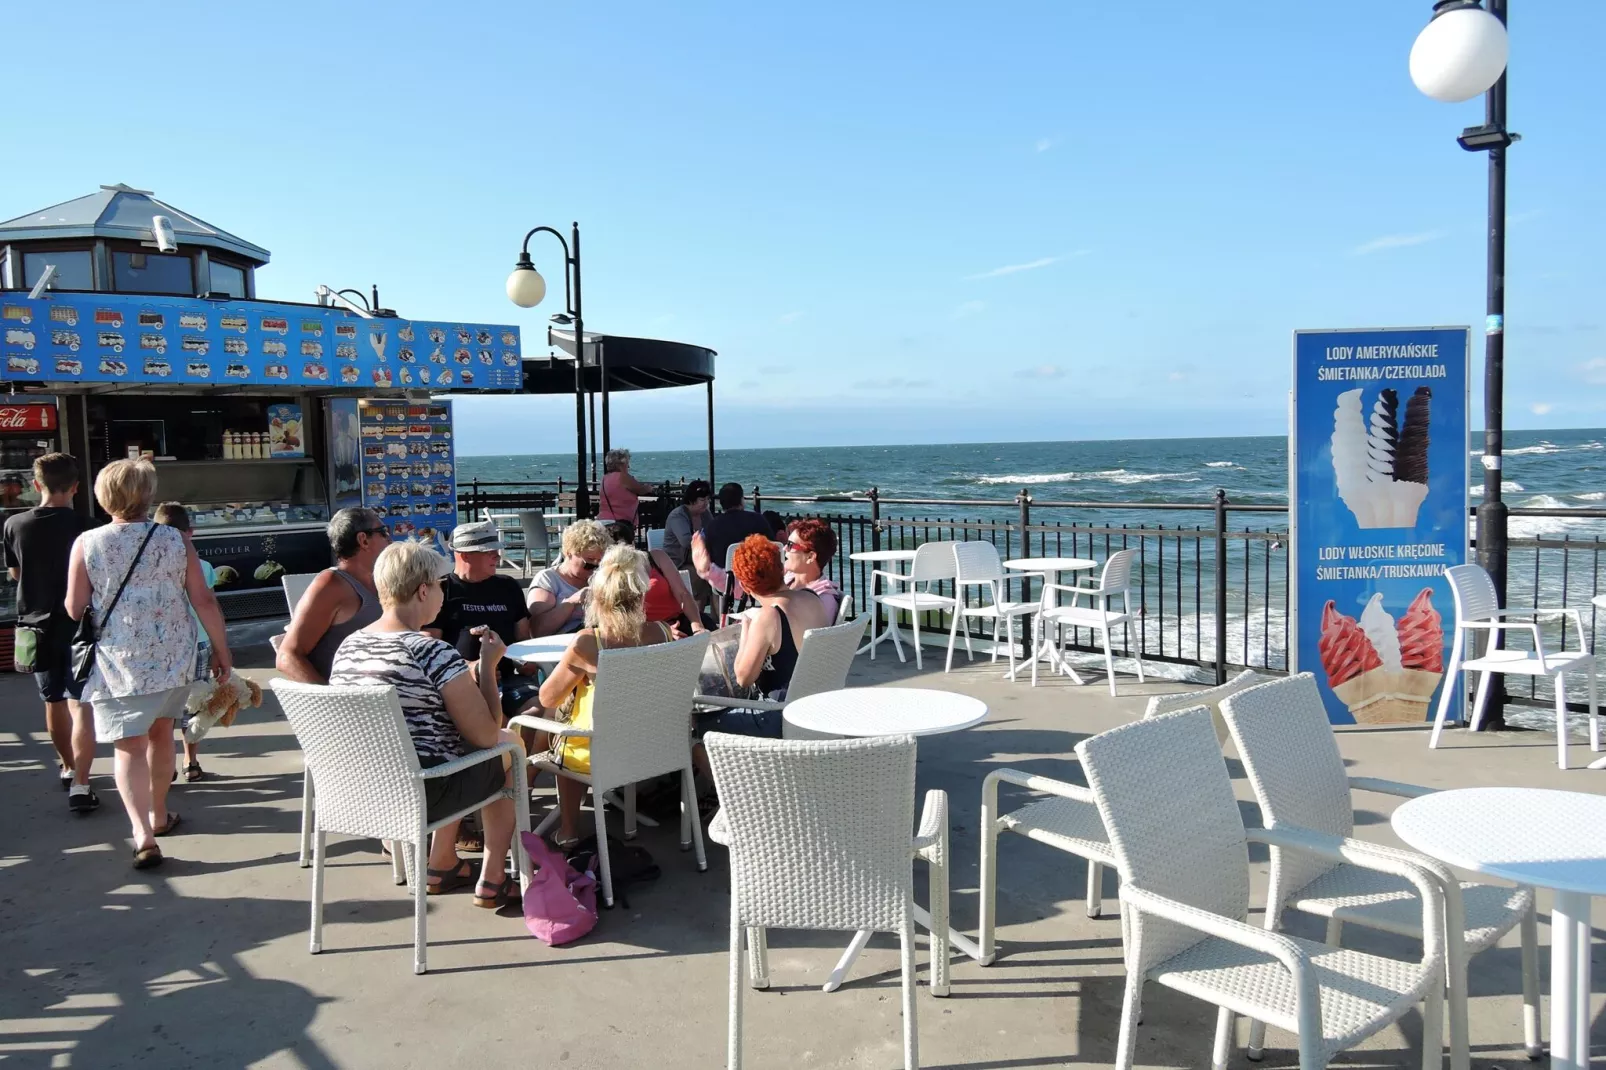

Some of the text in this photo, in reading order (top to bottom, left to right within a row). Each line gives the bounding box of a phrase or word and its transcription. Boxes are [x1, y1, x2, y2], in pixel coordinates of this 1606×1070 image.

[1326, 343, 1439, 361] LODY AMERYKAŃSKIE
[1317, 365, 1447, 381] ŚMIETANKA/CZEKOLADA
[1319, 543, 1445, 561] LODY WŁOSKIE KRĘCONE
[1316, 564, 1447, 581] ŚMIETANKA/TRUSKAWKA
[461, 603, 486, 613] TESTER
